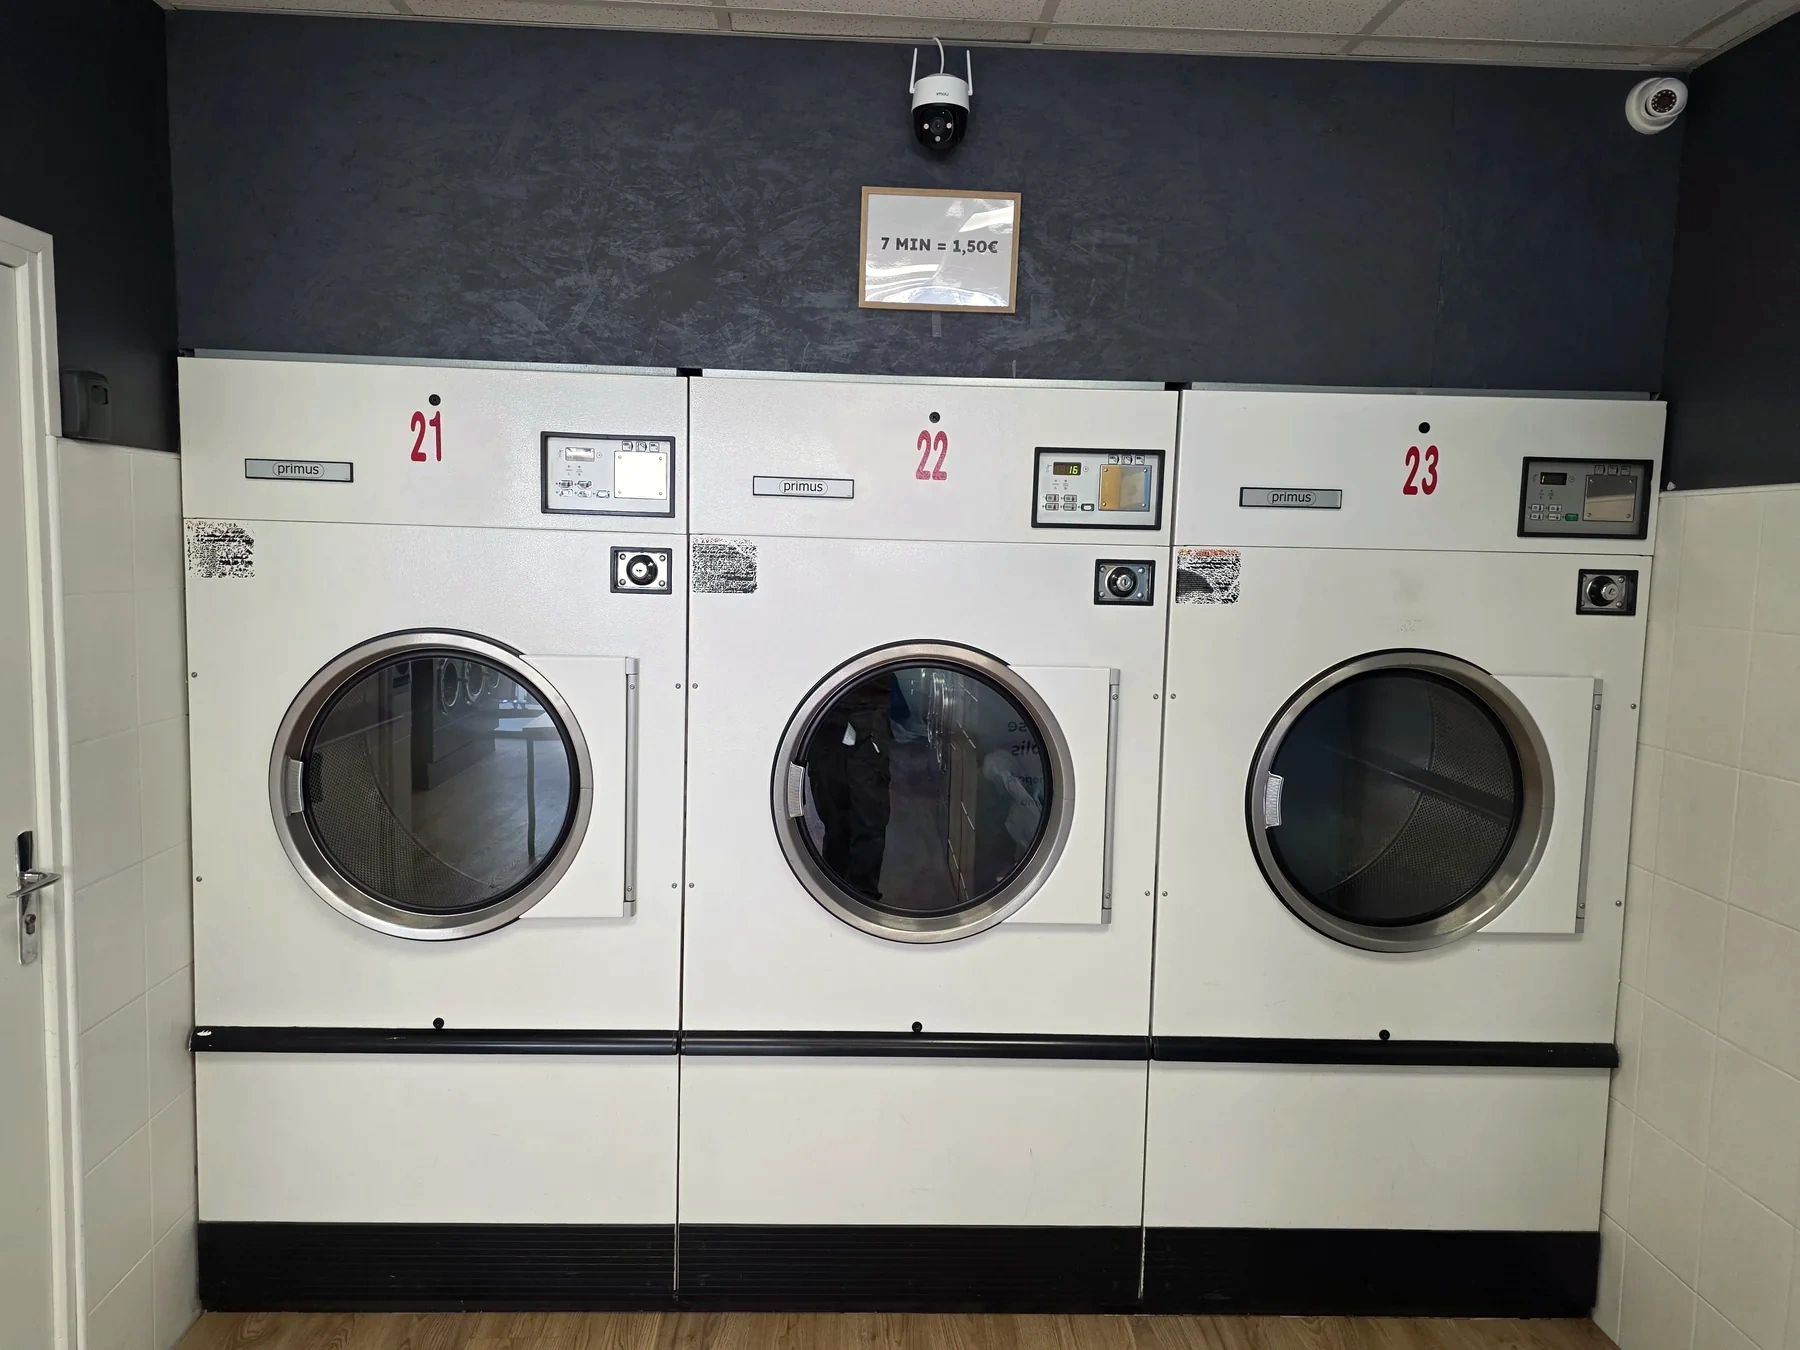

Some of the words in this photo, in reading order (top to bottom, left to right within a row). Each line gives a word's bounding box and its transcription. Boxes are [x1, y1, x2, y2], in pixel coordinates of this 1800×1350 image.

[881, 236, 890, 250] 7
[895, 237, 931, 252] MIN
[937, 242, 947, 251] =
[953, 239, 999, 256] 1,50€
[410, 411, 442, 463] 21
[916, 430, 948, 481] 22
[277, 463, 320, 476] primus
[1068, 465, 1079, 475] 16
[1402, 445, 1439, 496] 23
[783, 480, 824, 493] primus
[1271, 491, 1312, 504] primus
